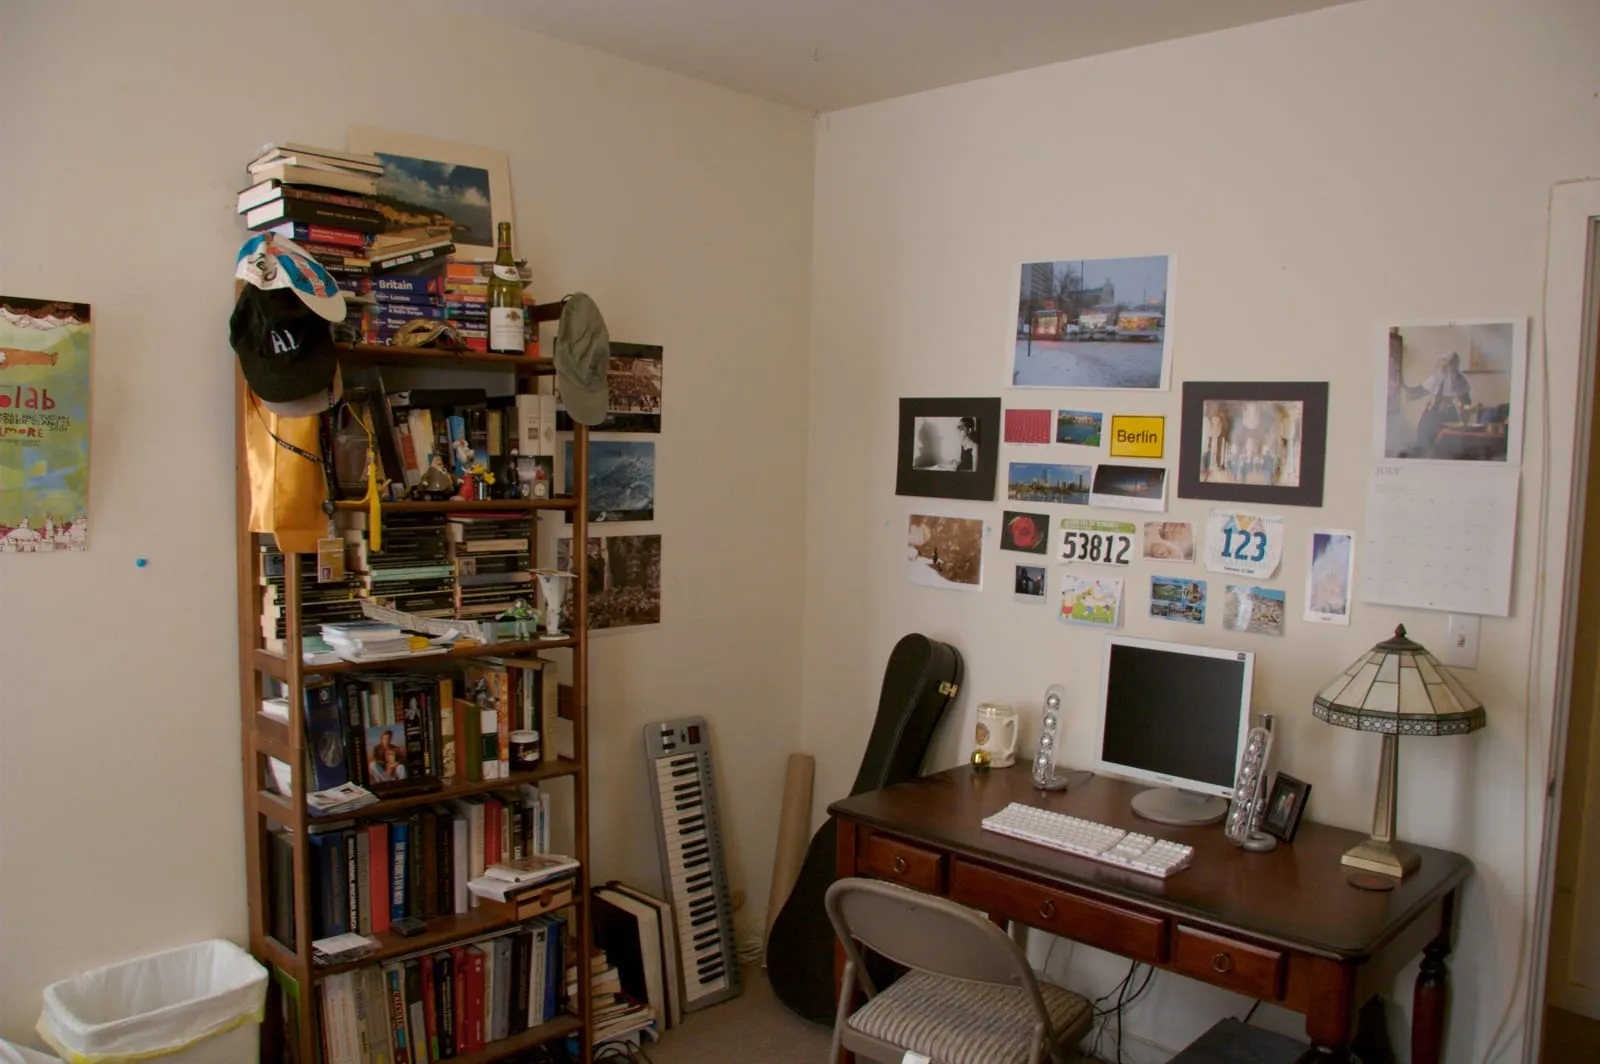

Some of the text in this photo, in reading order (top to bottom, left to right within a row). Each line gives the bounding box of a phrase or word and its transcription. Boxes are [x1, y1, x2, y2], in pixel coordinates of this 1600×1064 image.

[378, 279, 414, 290] Britain
[1117, 428, 1159, 445] Berlin
[1375, 465, 1402, 477] JULY
[1062, 531, 1132, 565] 53812
[1220, 527, 1268, 563] 123
